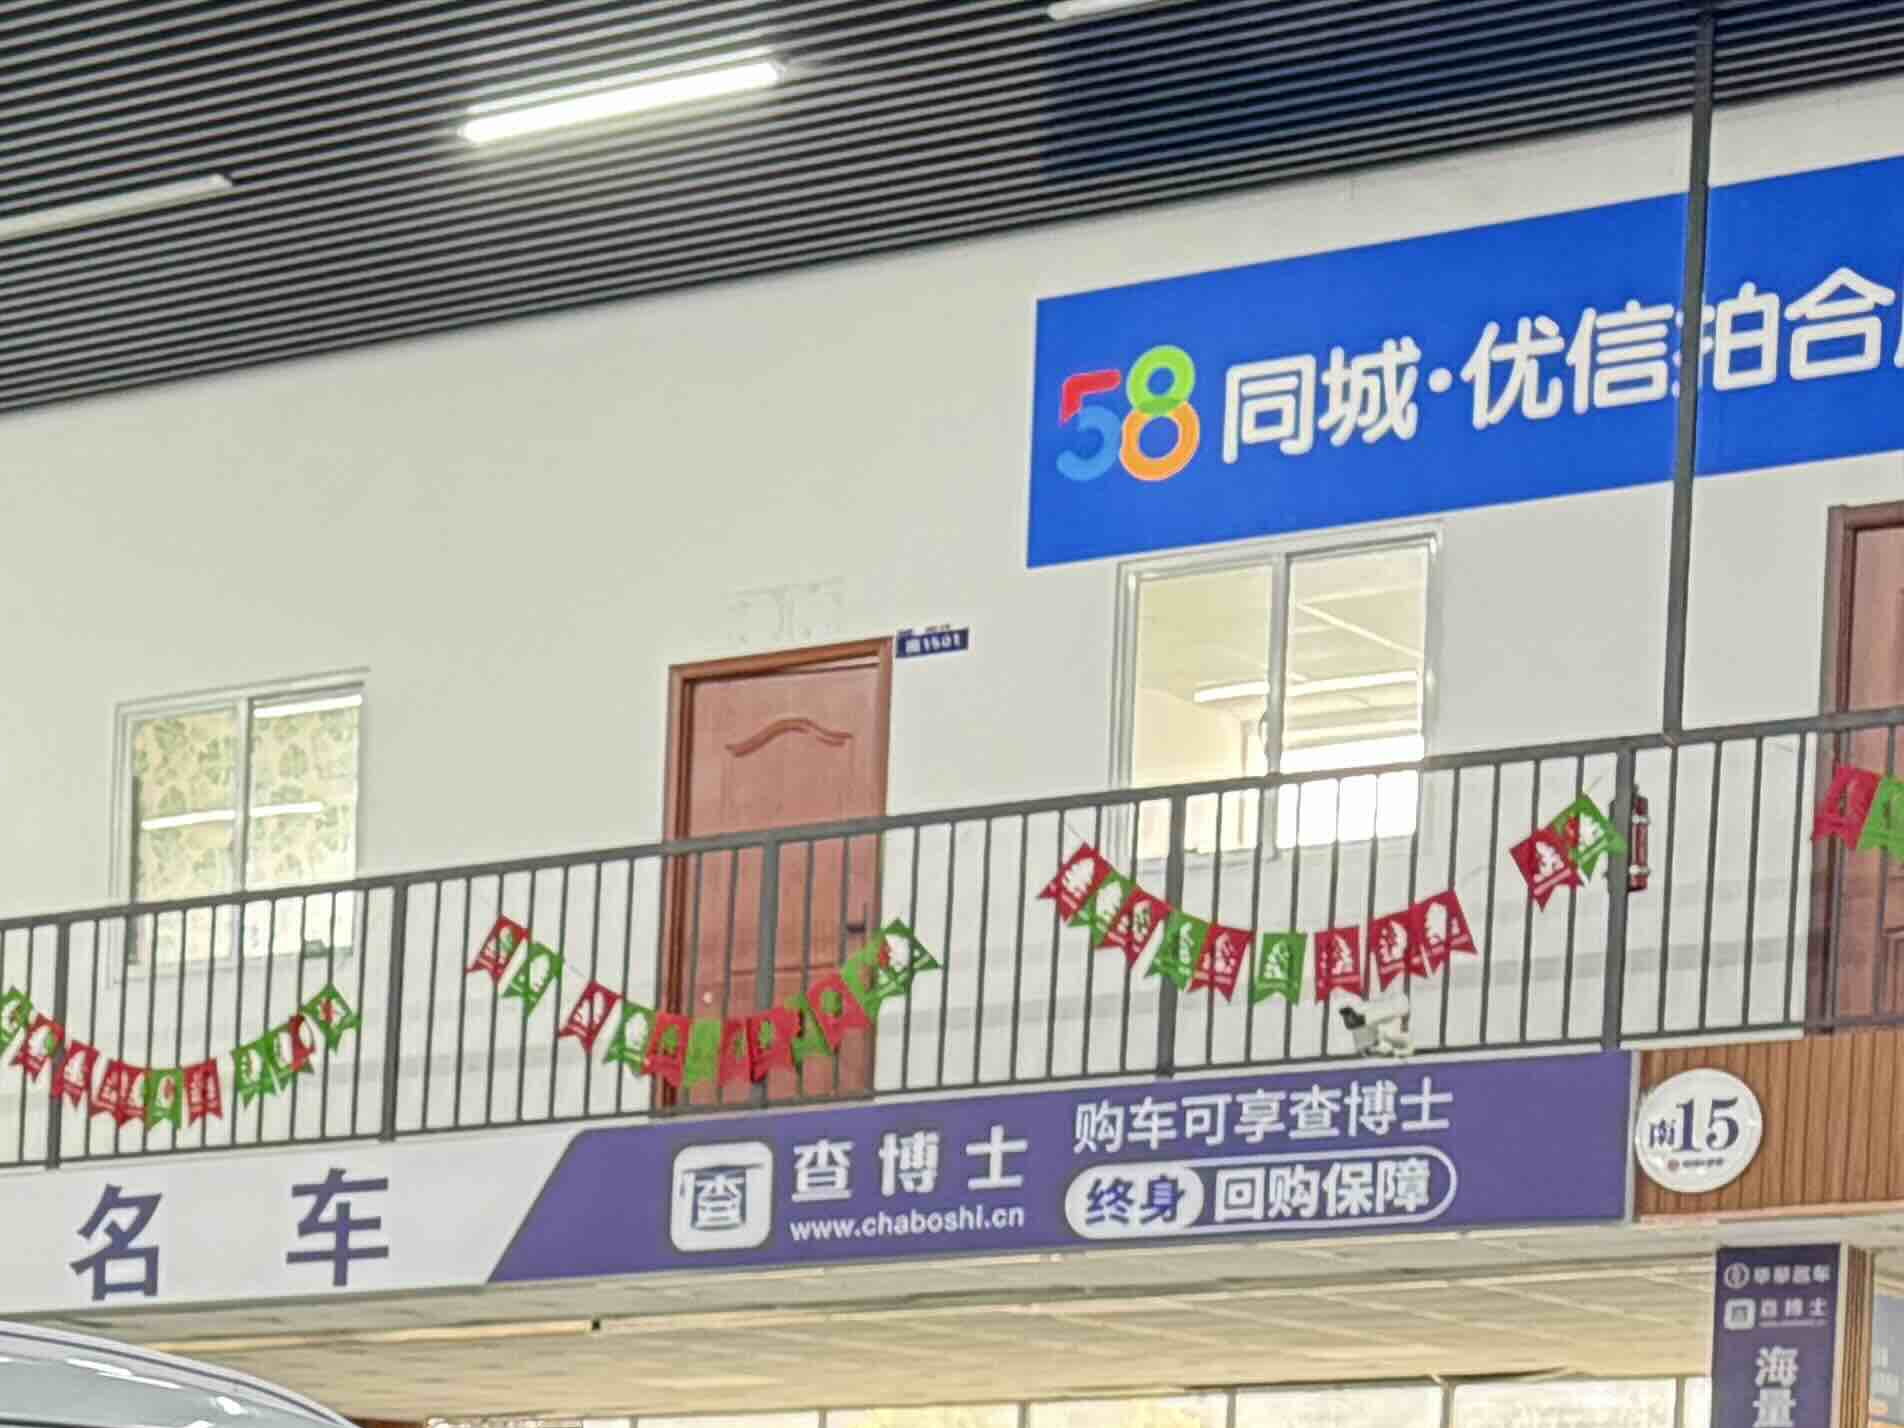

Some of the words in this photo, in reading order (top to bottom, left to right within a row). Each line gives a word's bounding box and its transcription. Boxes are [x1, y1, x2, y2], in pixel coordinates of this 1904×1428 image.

[1073, 1076, 1454, 1154] 购车可享查博士
[792, 1125, 1028, 1202] 查博士
[1085, 1175, 1185, 1228] 终身
[1214, 1158, 1432, 1222] 回购保障
[790, 1204, 1025, 1242] www.chaboshi.cn
